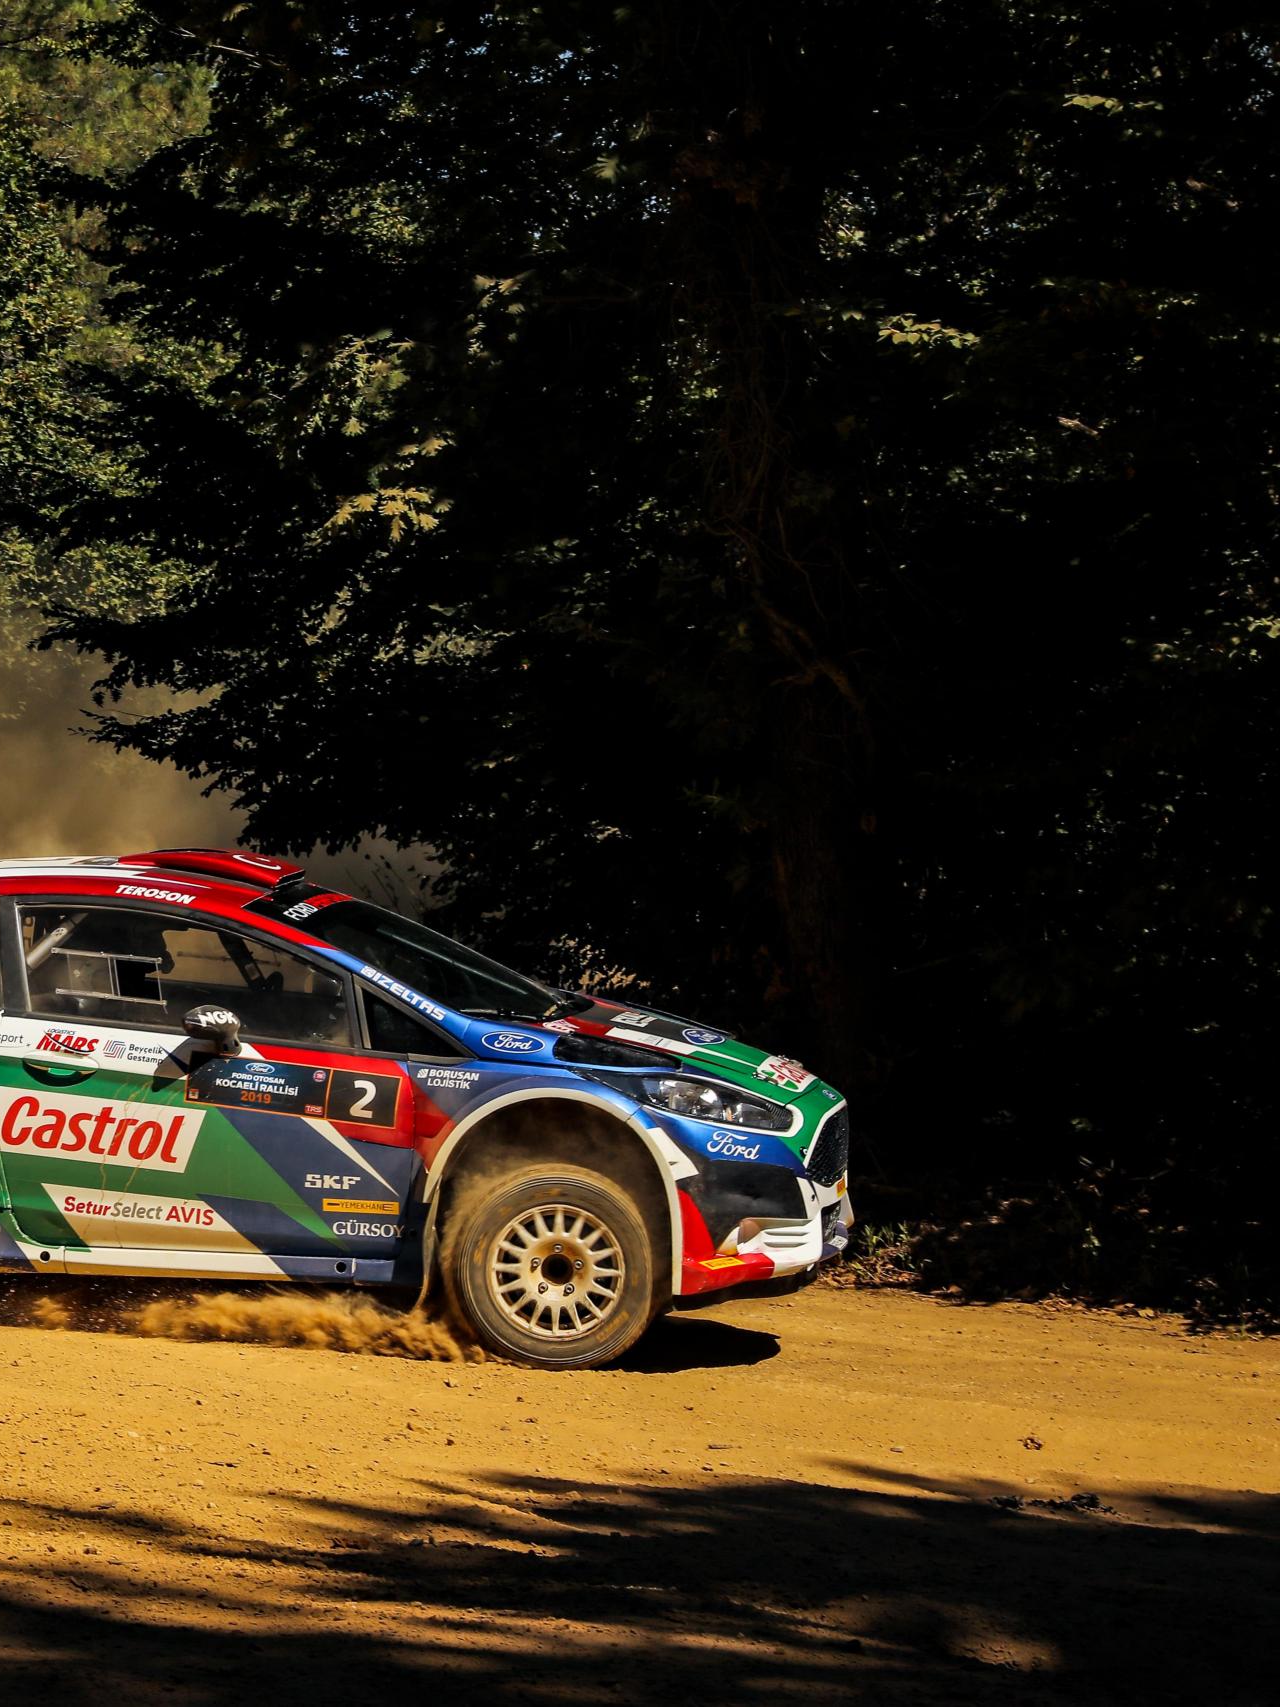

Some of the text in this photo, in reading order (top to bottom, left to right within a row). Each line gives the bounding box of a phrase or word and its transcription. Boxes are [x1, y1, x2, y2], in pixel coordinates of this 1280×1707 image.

[115, 884, 196, 904] TEROSON
[283, 902, 318, 921] FORD
[197, 1010, 238, 1027] NGK
[36, 1032, 99, 1056] MARS
[129, 1043, 163, 1055] Beyçelik
[232, 1072, 285, 1085] FORD OTOSAN
[427, 1077, 471, 1089] LOJİSTİK
[429, 1069, 480, 1081] BORUSAN
[216, 1078, 299, 1097] KOCAELİ RALLİSİ
[240, 1090, 272, 1104] 2019
[349, 1080, 377, 1118] 2
[1, 1096, 185, 1163] Castrol
[707, 1130, 760, 1160] Ford
[304, 1173, 361, 1190] SKF
[166, 1202, 214, 1226] AVIS
[332, 1219, 405, 1238] GÜRSOY
